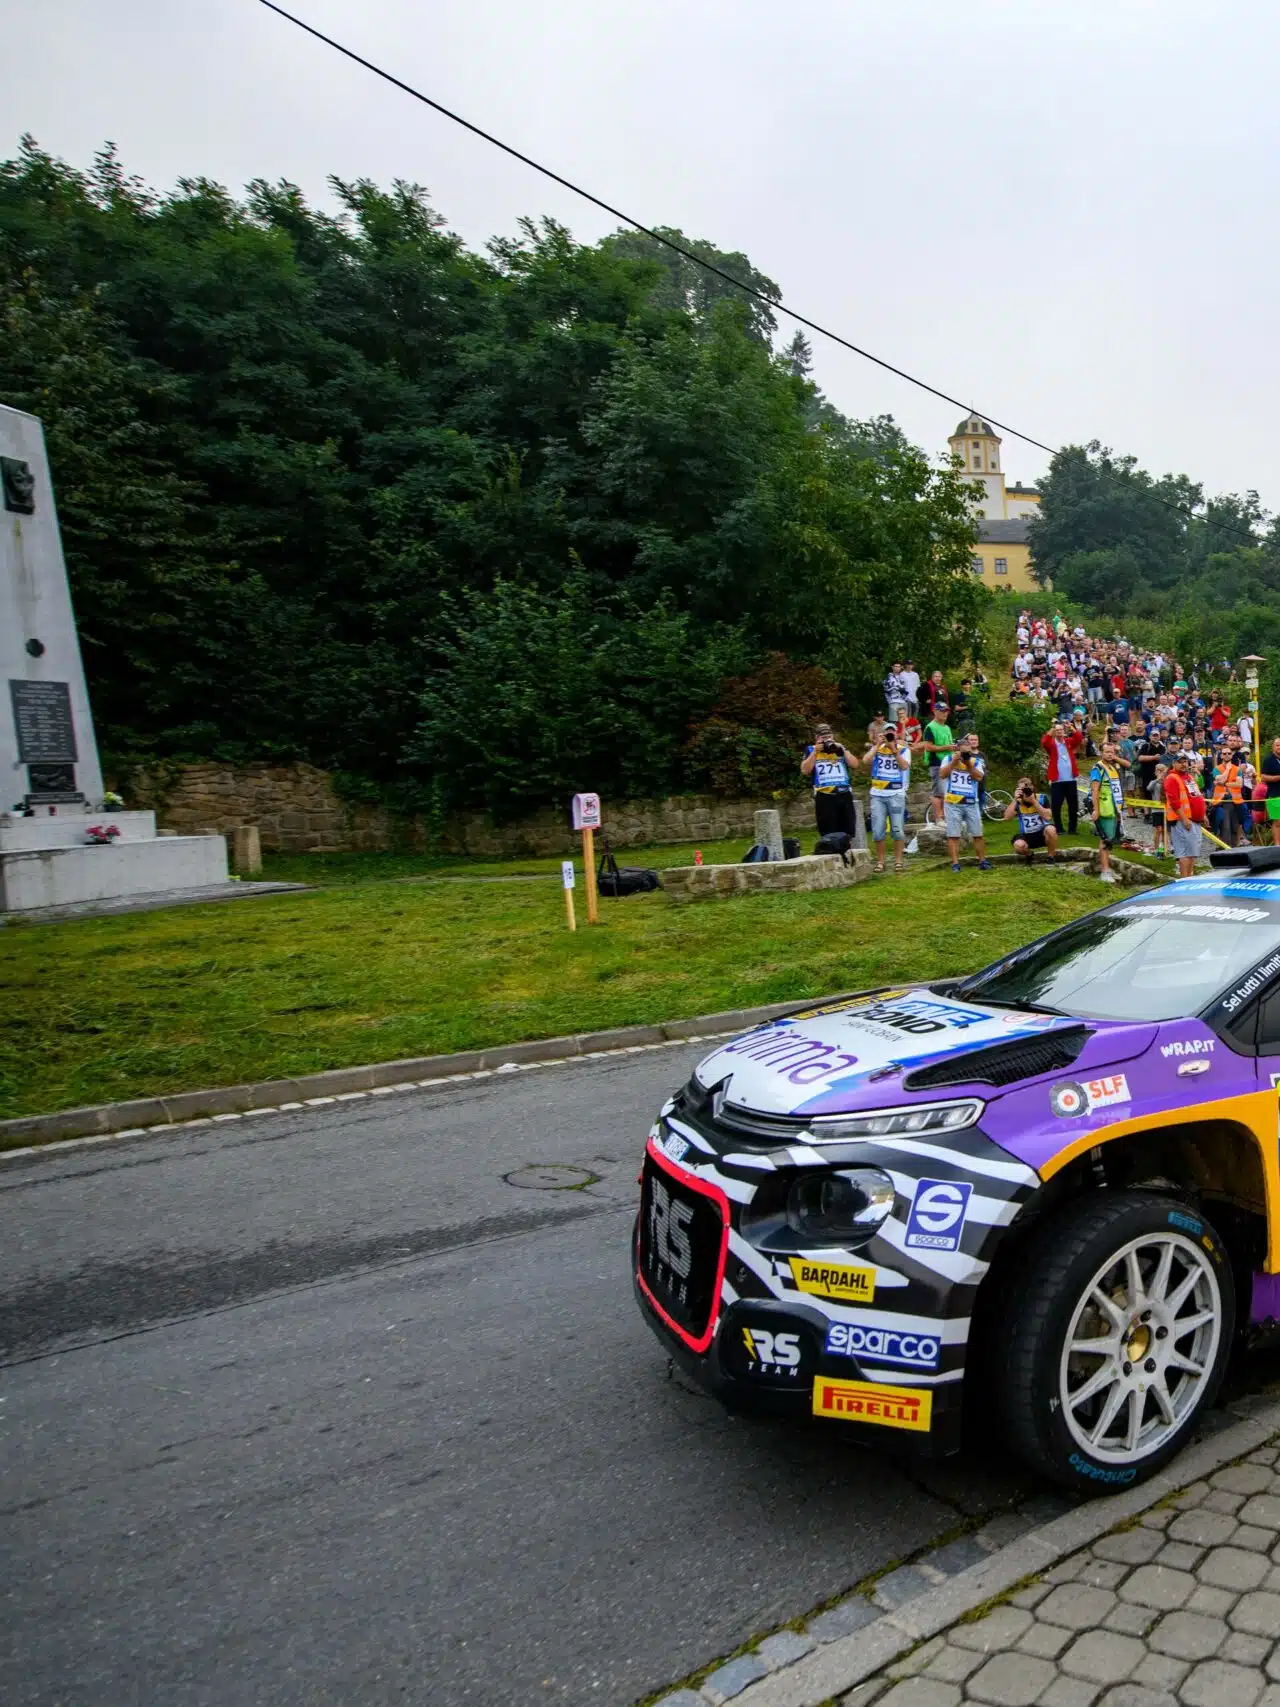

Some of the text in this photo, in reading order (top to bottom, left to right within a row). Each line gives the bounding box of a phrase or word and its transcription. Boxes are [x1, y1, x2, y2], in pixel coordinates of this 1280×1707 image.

[817, 764, 841, 776] 271
[1237, 975, 1260, 998] tutti
[701, 1030, 858, 1085] prima
[1160, 1039, 1215, 1058] WRAP.IT
[1088, 1076, 1123, 1099] SLF
[801, 1266, 869, 1292] BARDAHL
[750, 1329, 801, 1366] RS
[828, 1324, 938, 1362] sparco
[748, 1361, 800, 1377] TEAM
[822, 1386, 920, 1422] PIRELLI
